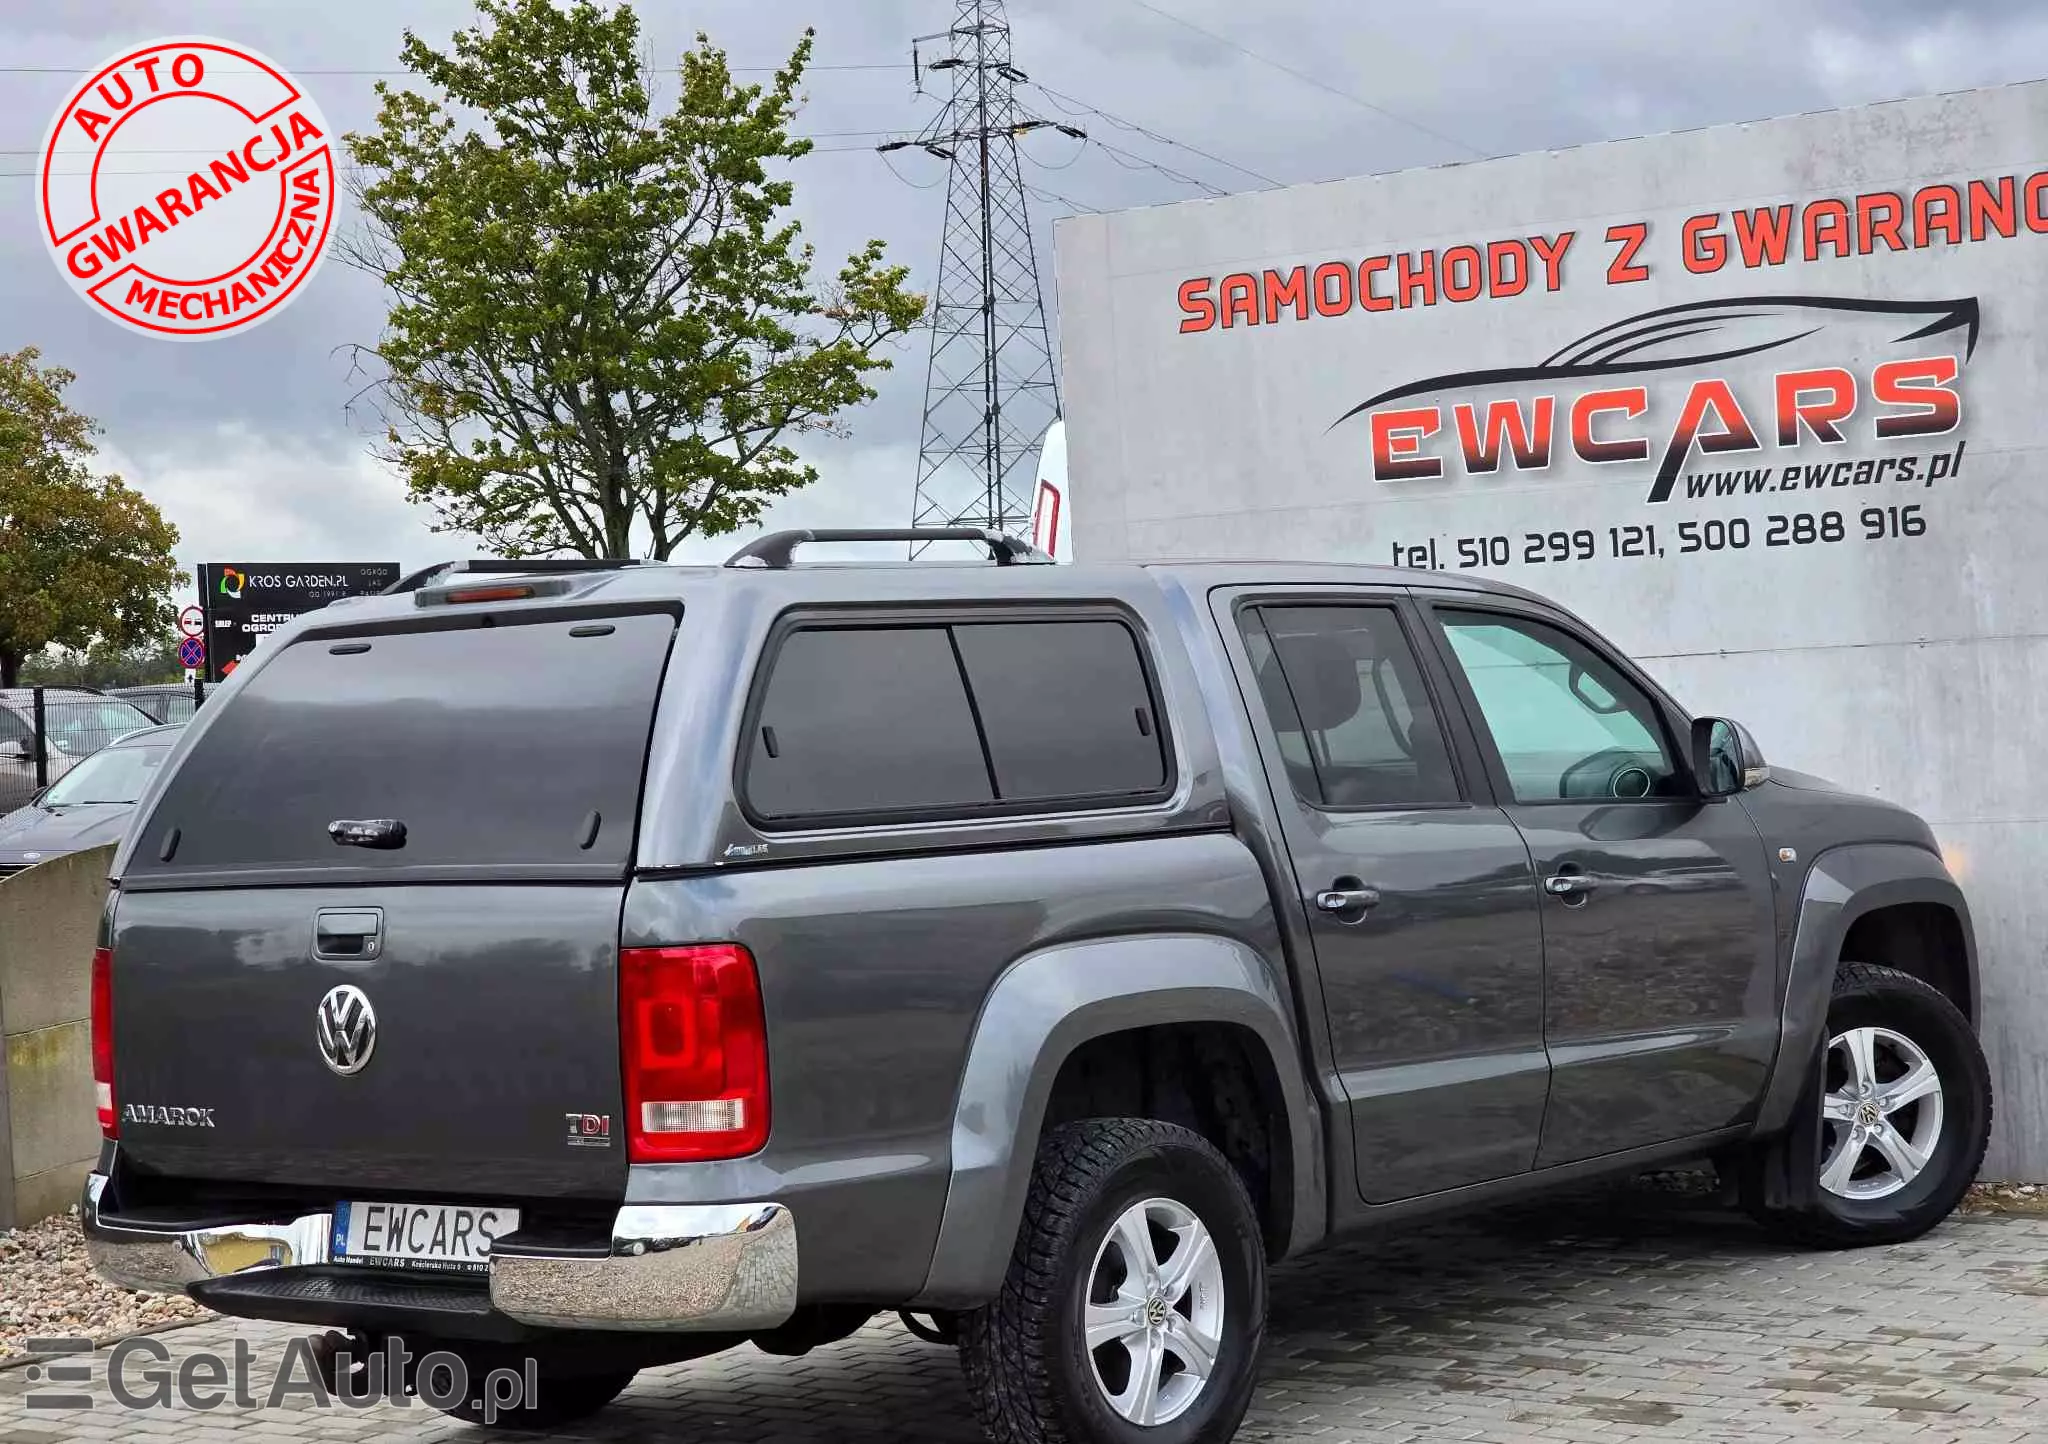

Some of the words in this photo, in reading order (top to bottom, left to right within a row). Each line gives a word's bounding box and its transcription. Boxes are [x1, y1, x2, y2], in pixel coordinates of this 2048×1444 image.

[1178, 231, 1576, 333] SAMOCHODY
[1606, 222, 1649, 285] Z
[1369, 354, 1963, 503] EWCARS
[1686, 440, 1966, 498] www.ewcars.pl
[1392, 537, 1445, 570] tel.
[1457, 536, 1510, 568] 510
[1524, 529, 1595, 563] 299
[1609, 524, 1664, 558] 121,
[1677, 517, 1750, 552] 500
[1766, 511, 1845, 546] 288
[1860, 504, 1927, 539] 916
[249, 575, 281, 588] KROS
[285, 575, 349, 588] GARDEN.PL
[123, 1103, 215, 1127] AMAROK
[565, 1113, 610, 1136] TDI
[335, 1233, 346, 1247] PL
[363, 1206, 498, 1257] EWCARS
[369, 1256, 406, 1268] EWCARS
